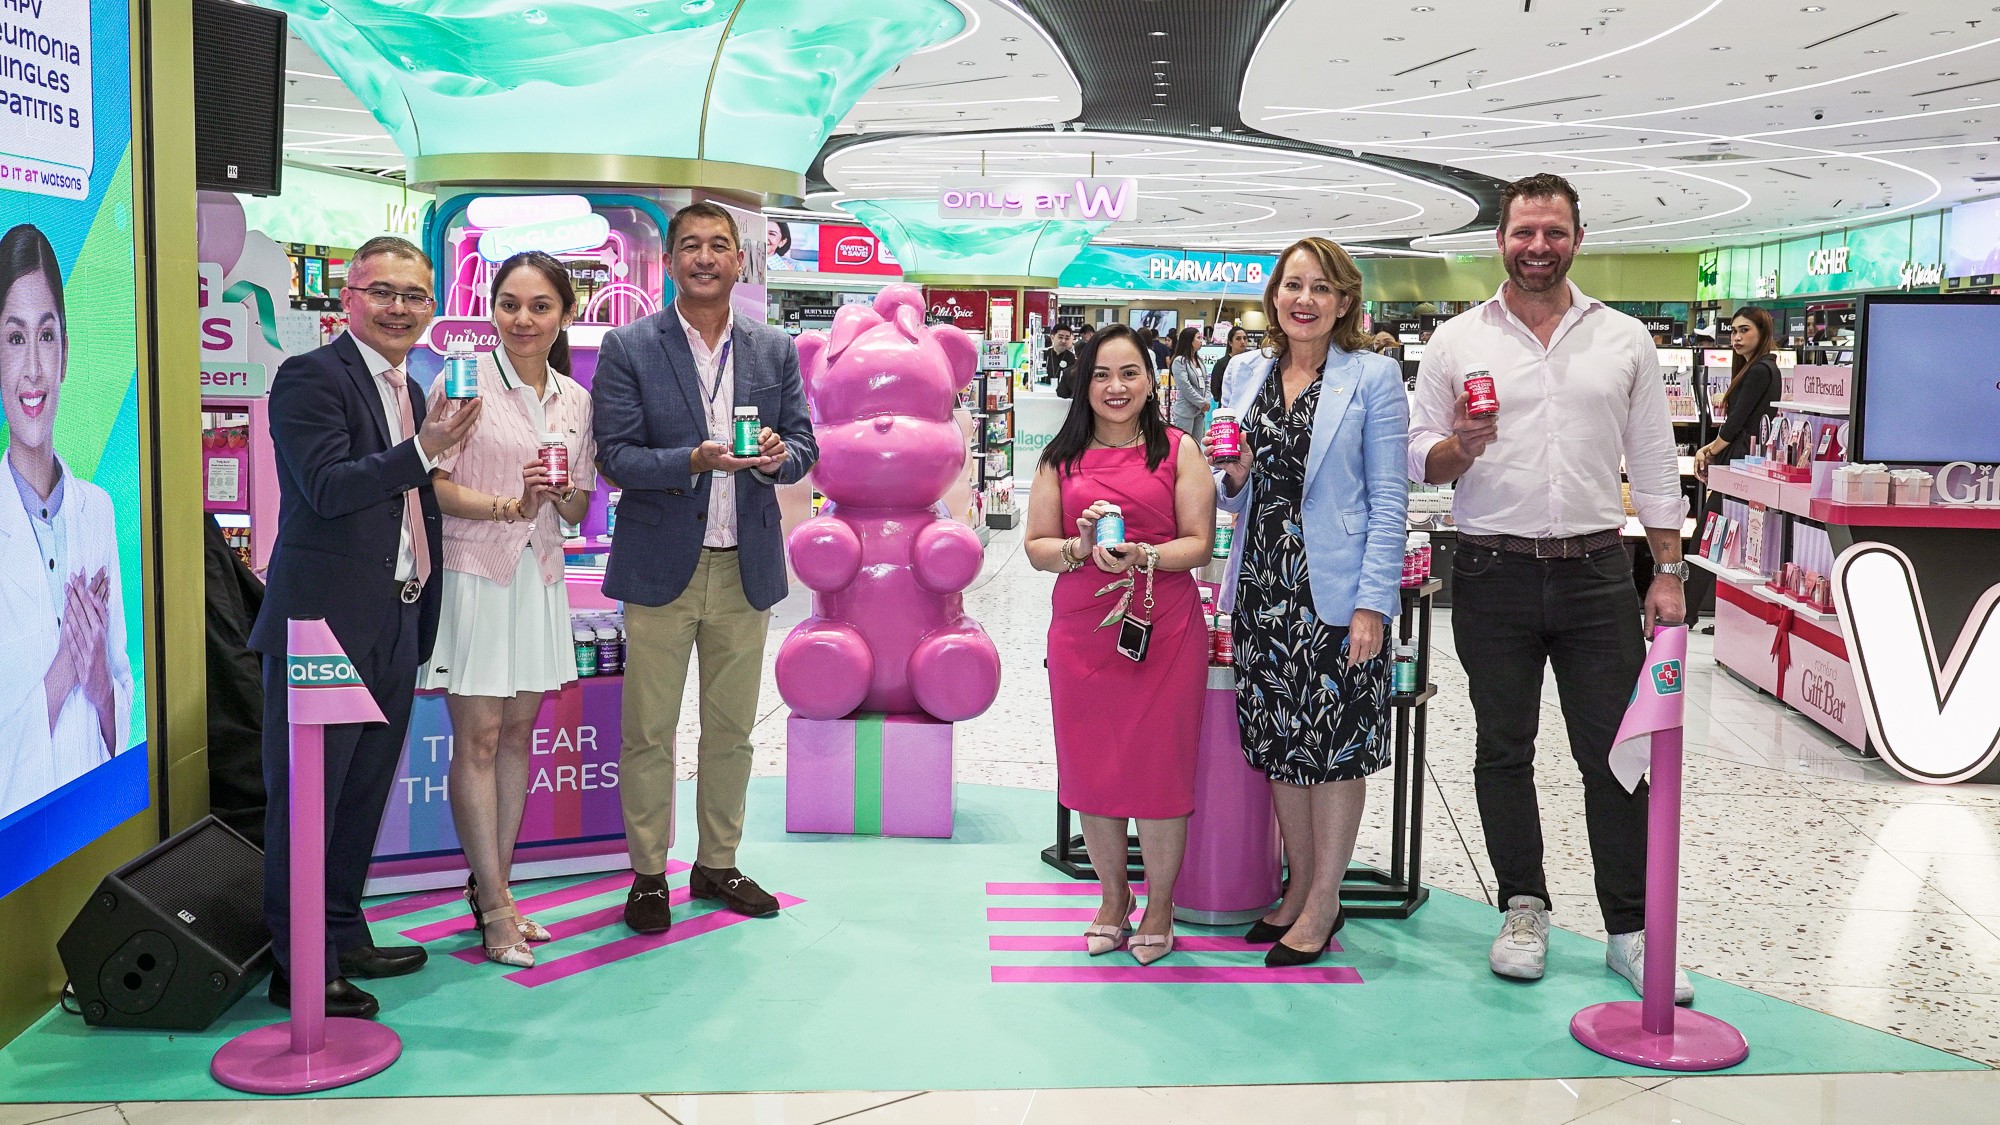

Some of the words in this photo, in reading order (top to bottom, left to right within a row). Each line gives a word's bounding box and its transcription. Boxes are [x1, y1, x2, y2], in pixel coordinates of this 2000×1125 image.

[69, 107, 79, 128] B
[12, 167, 22, 180] IT
[41, 171, 82, 191] watsons
[1074, 179, 1130, 220] W
[840, 244, 868, 252] SWITCH
[1150, 258, 1242, 282] PHARMACY
[1806, 246, 1850, 277] CASHIER
[953, 306, 974, 320] Spice
[1804, 375, 1817, 395] Gift
[1816, 377, 1845, 397] Personal
[1014, 430, 1053, 449] llage
[288, 662, 363, 681] atson
[1802, 669, 1823, 709] Gift
[1822, 680, 1846, 724] Bar
[526, 762, 619, 794] ARES
